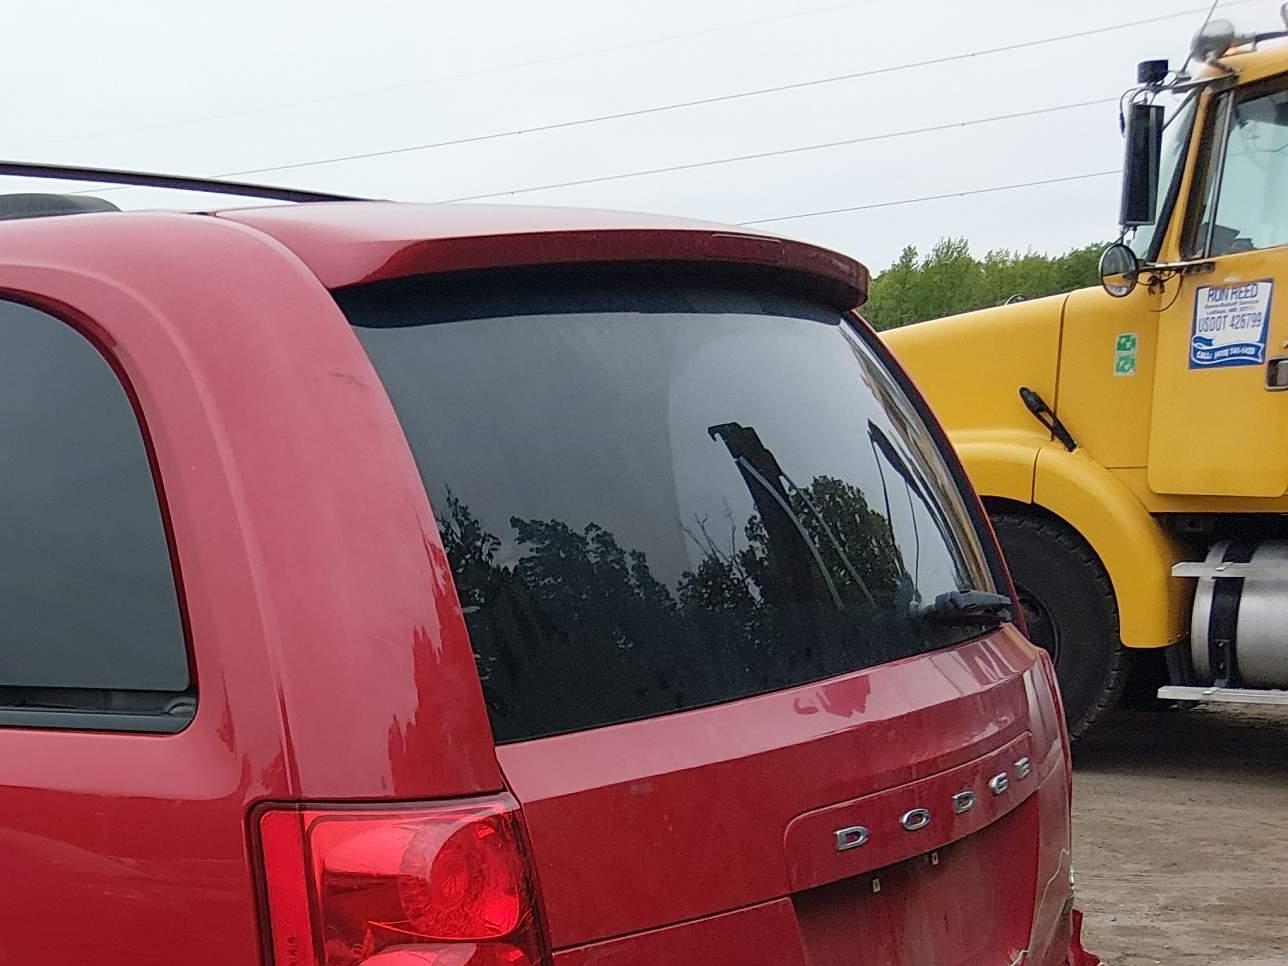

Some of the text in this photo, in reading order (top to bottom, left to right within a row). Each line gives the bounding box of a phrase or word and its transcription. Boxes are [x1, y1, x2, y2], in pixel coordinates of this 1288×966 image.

[1198, 312, 1262, 332] USDOT 426799
[834, 757, 1030, 850] DODGE
